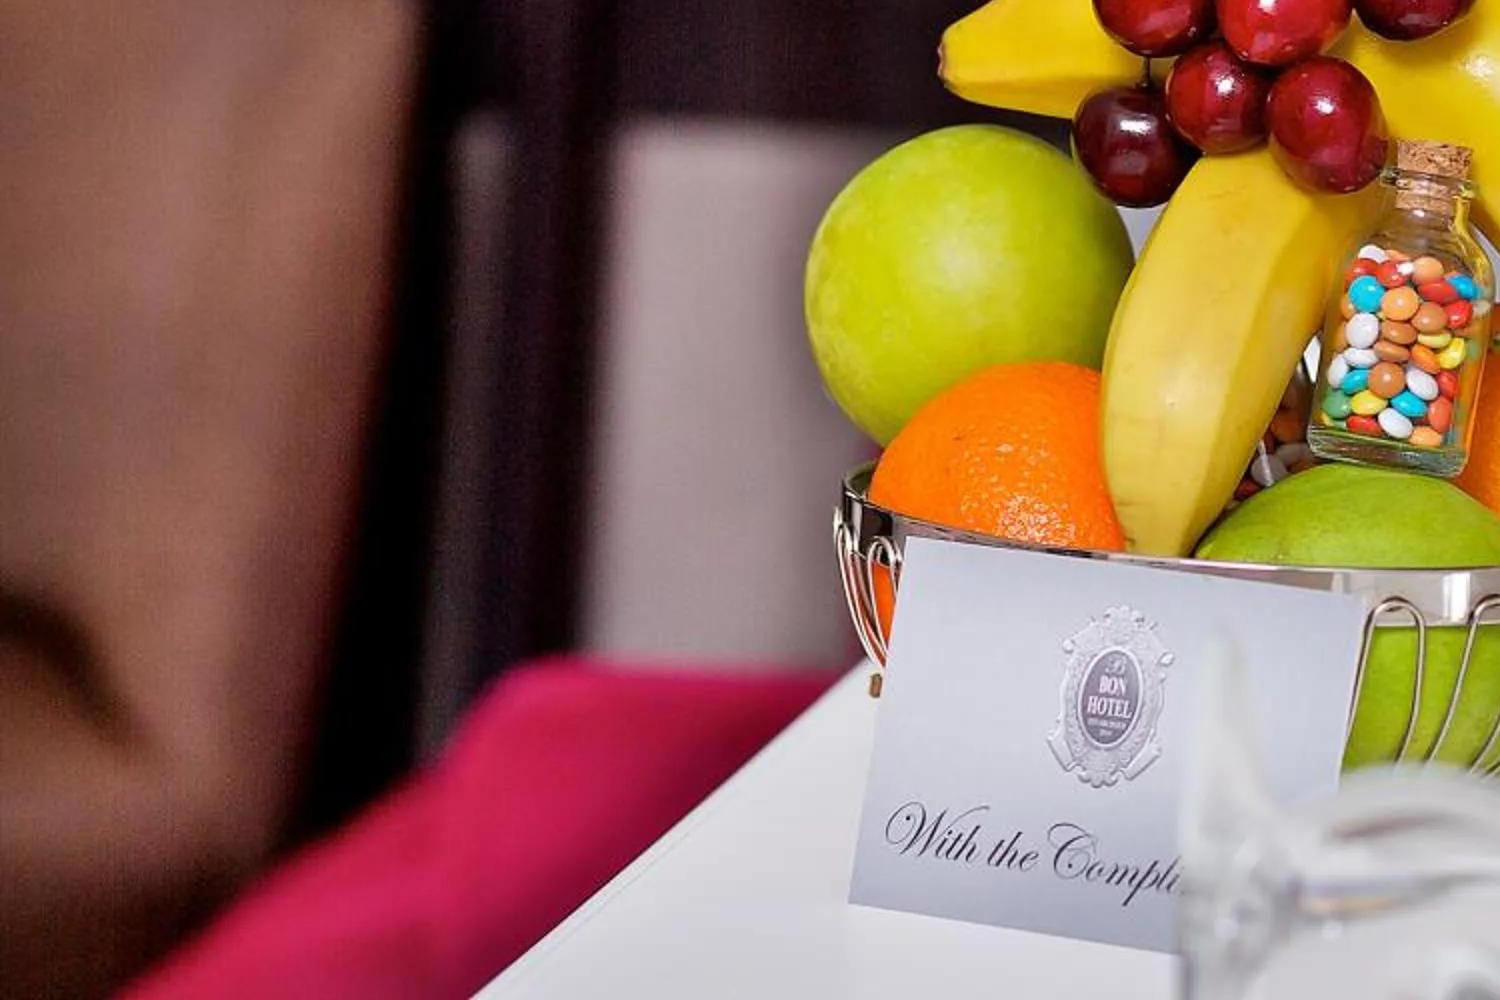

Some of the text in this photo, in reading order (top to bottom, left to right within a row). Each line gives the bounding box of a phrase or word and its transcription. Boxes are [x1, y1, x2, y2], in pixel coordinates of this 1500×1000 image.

[1099, 674, 1127, 697] BON
[1087, 694, 1133, 719] HOTEL
[885, 801, 1183, 907] With the Compli
